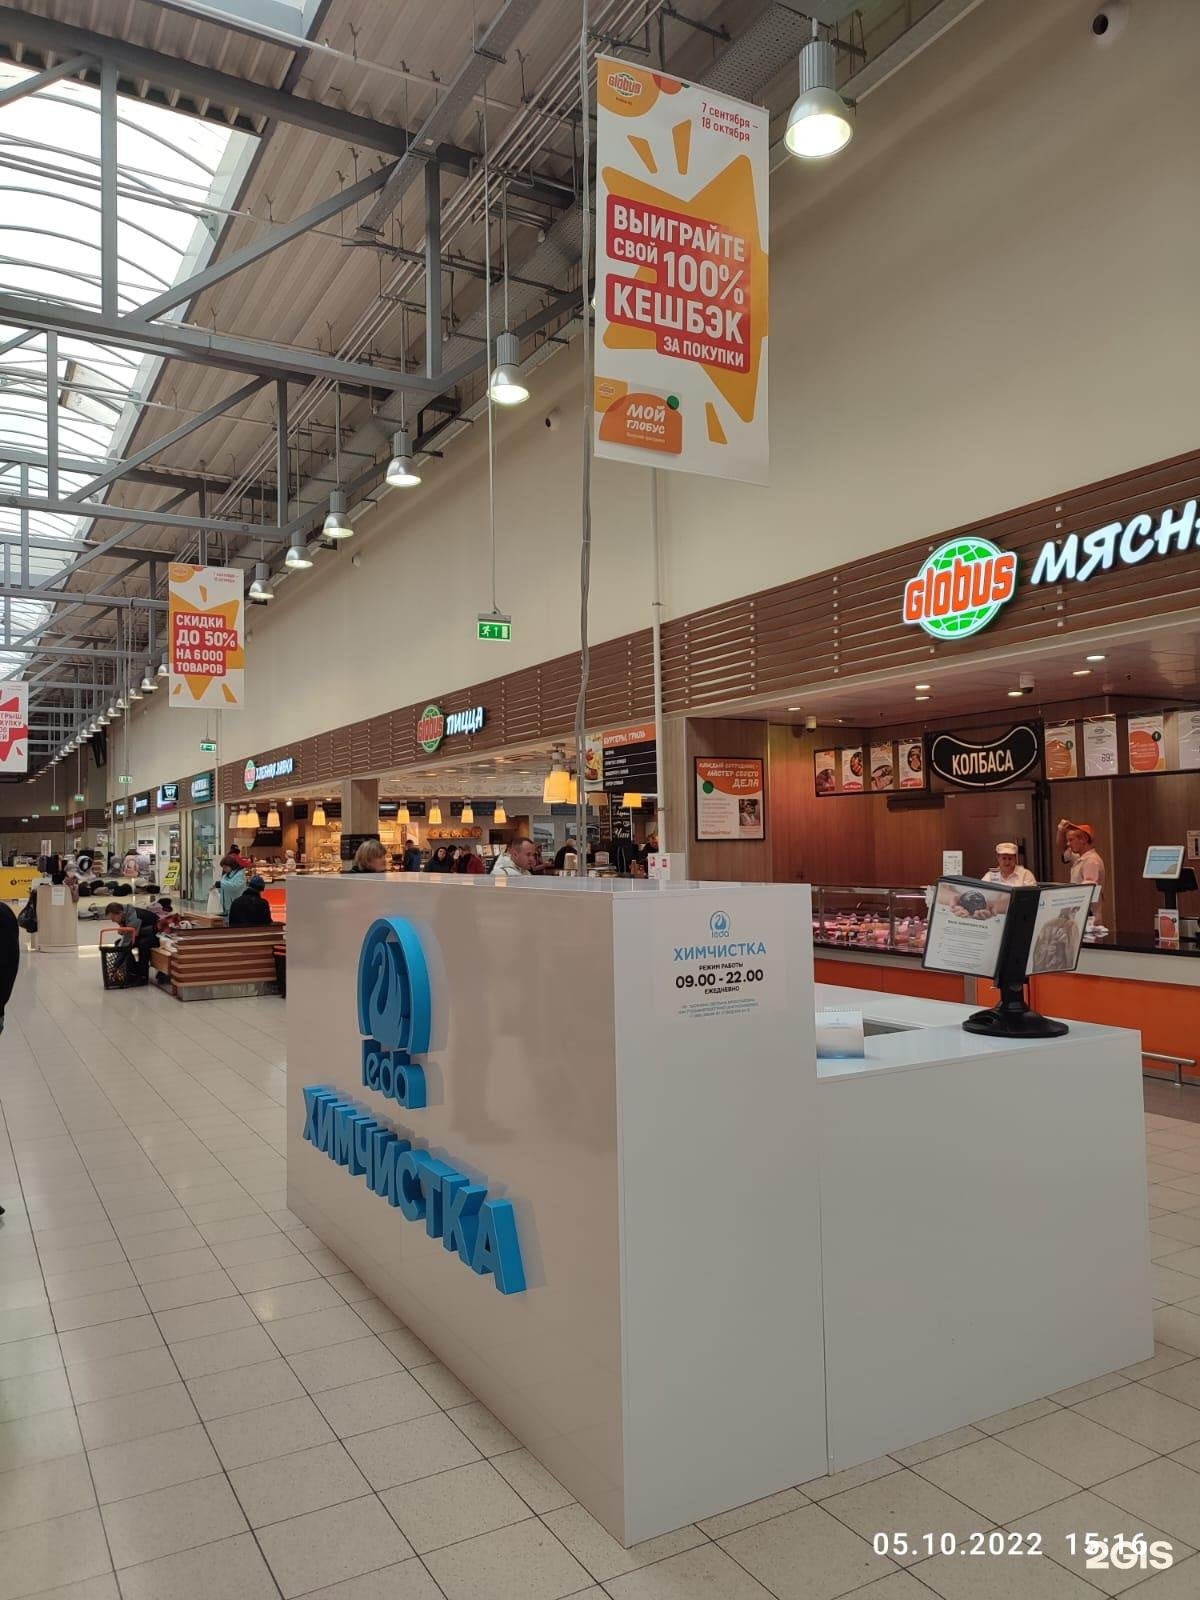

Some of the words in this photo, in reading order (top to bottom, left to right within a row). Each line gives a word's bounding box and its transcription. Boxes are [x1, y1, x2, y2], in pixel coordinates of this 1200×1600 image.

[702, 102, 707, 113] 7
[709, 107, 750, 128] сентября
[702, 117, 711, 129] 18
[713, 122, 750, 142] октября
[613, 204, 745, 262] ВЫИГРАЙТЕ
[613, 236, 658, 265] СВОЙ
[663, 251, 744, 305] 100%
[613, 282, 744, 345] КЕШБЭК
[663, 336, 680, 354] ЗА
[683, 341, 744, 368] ПОКУПКИ
[626, 403, 666, 423] МОЙ
[626, 419, 665, 434] ГЛОБУС
[905, 553, 1015, 621] Globus
[176, 614, 224, 629] СКИДКИ
[176, 629, 200, 647] ДО
[204, 630, 236, 648] 50%
[176, 648, 192, 660] НА
[176, 661, 224, 675] ТОВАРОВ
[446, 706, 483, 735] ПИЦЦА
[952, 749, 1015, 776] КОЛБАСА
[732, 778, 760, 789] ДЕЛА
[673, 941, 767, 961] ХИМЧИСТКА
[675, 973, 716, 989] 09.00
[726, 968, 764, 985] 22.00
[704, 985, 740, 995] ЕЖЕДНЕВНО
[303, 1084, 527, 1296] ХИМЧИСТКА
